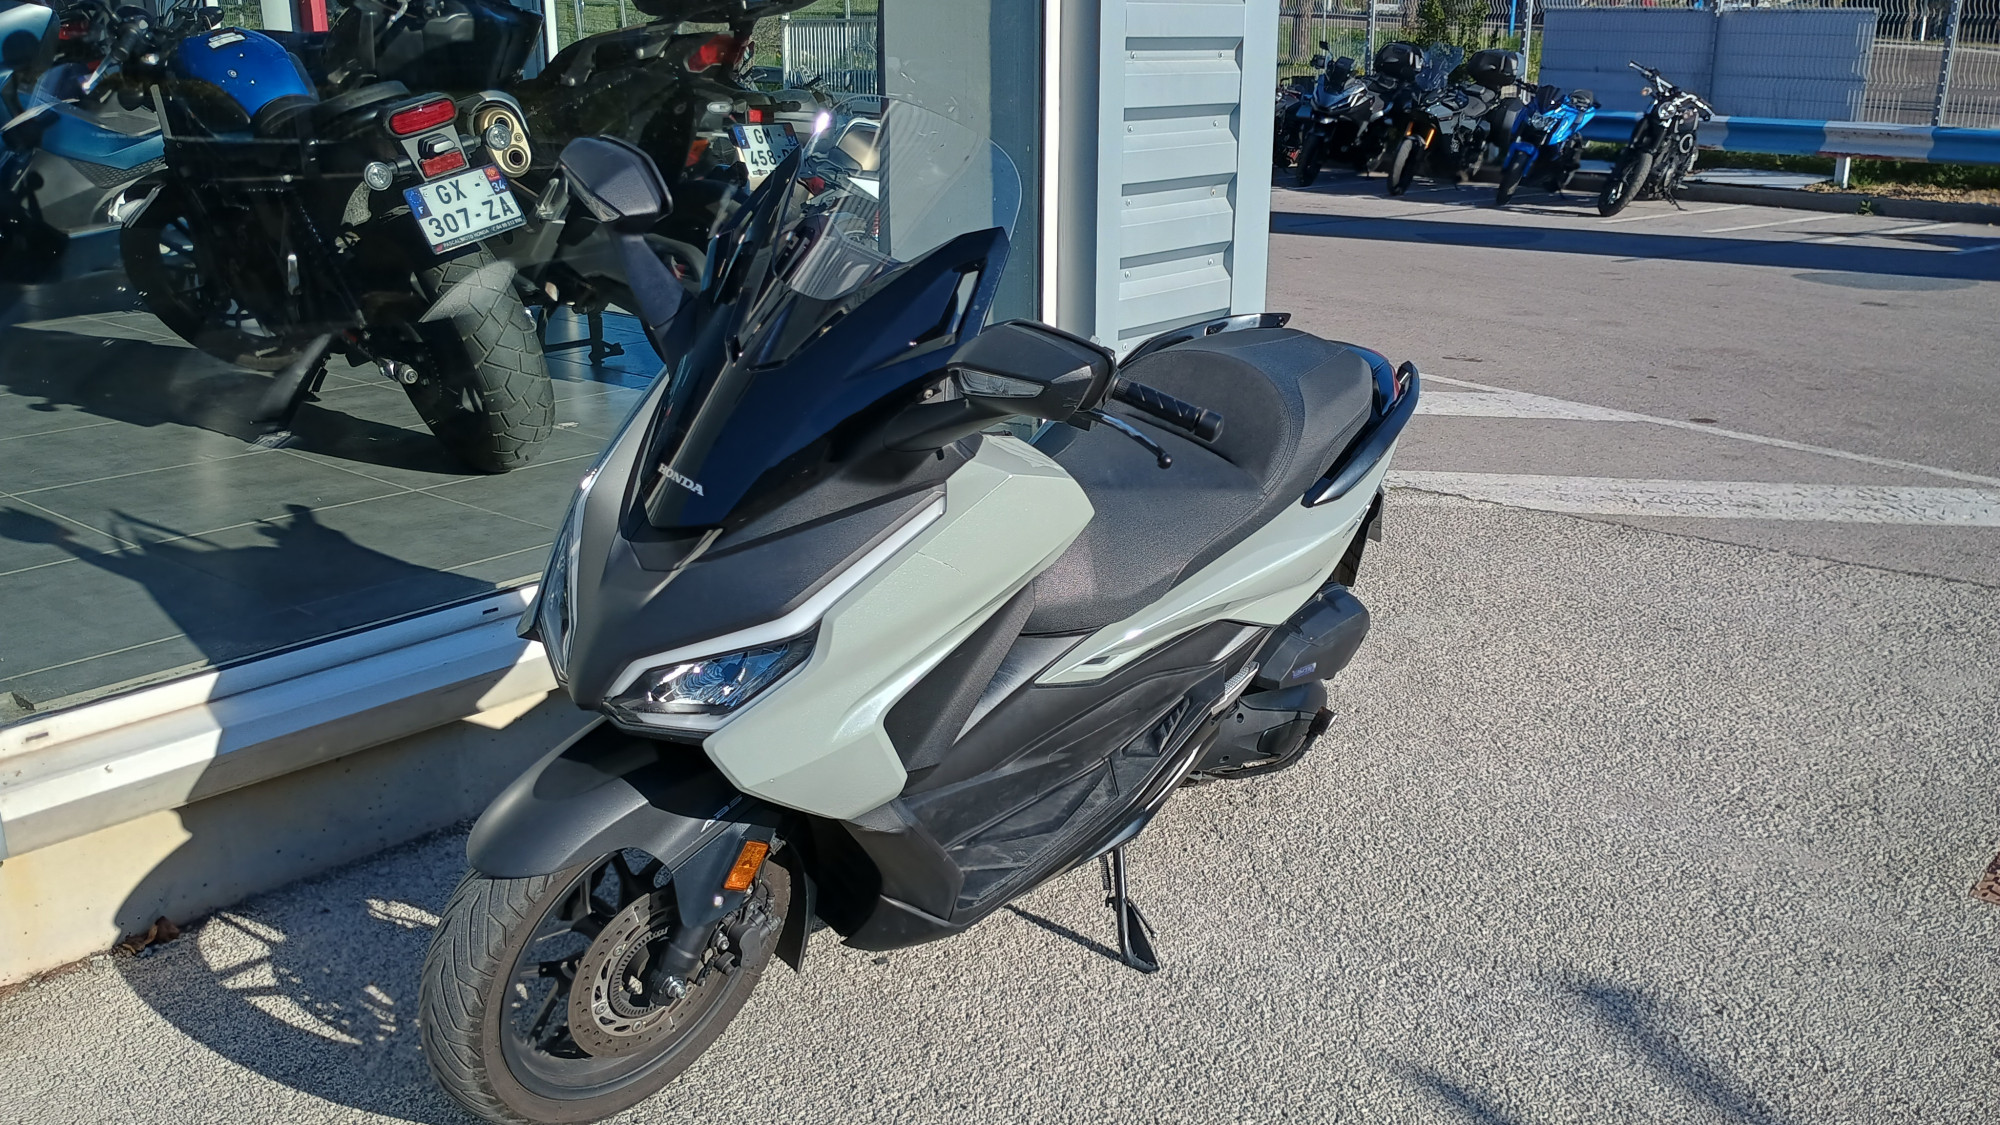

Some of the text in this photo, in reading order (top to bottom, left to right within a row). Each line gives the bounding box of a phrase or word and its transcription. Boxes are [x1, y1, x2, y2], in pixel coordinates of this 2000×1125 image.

[491, 179, 506, 193] 34
[417, 206, 424, 215] F
[428, 196, 515, 238] 307-ZA
[658, 463, 704, 496] HONDA
